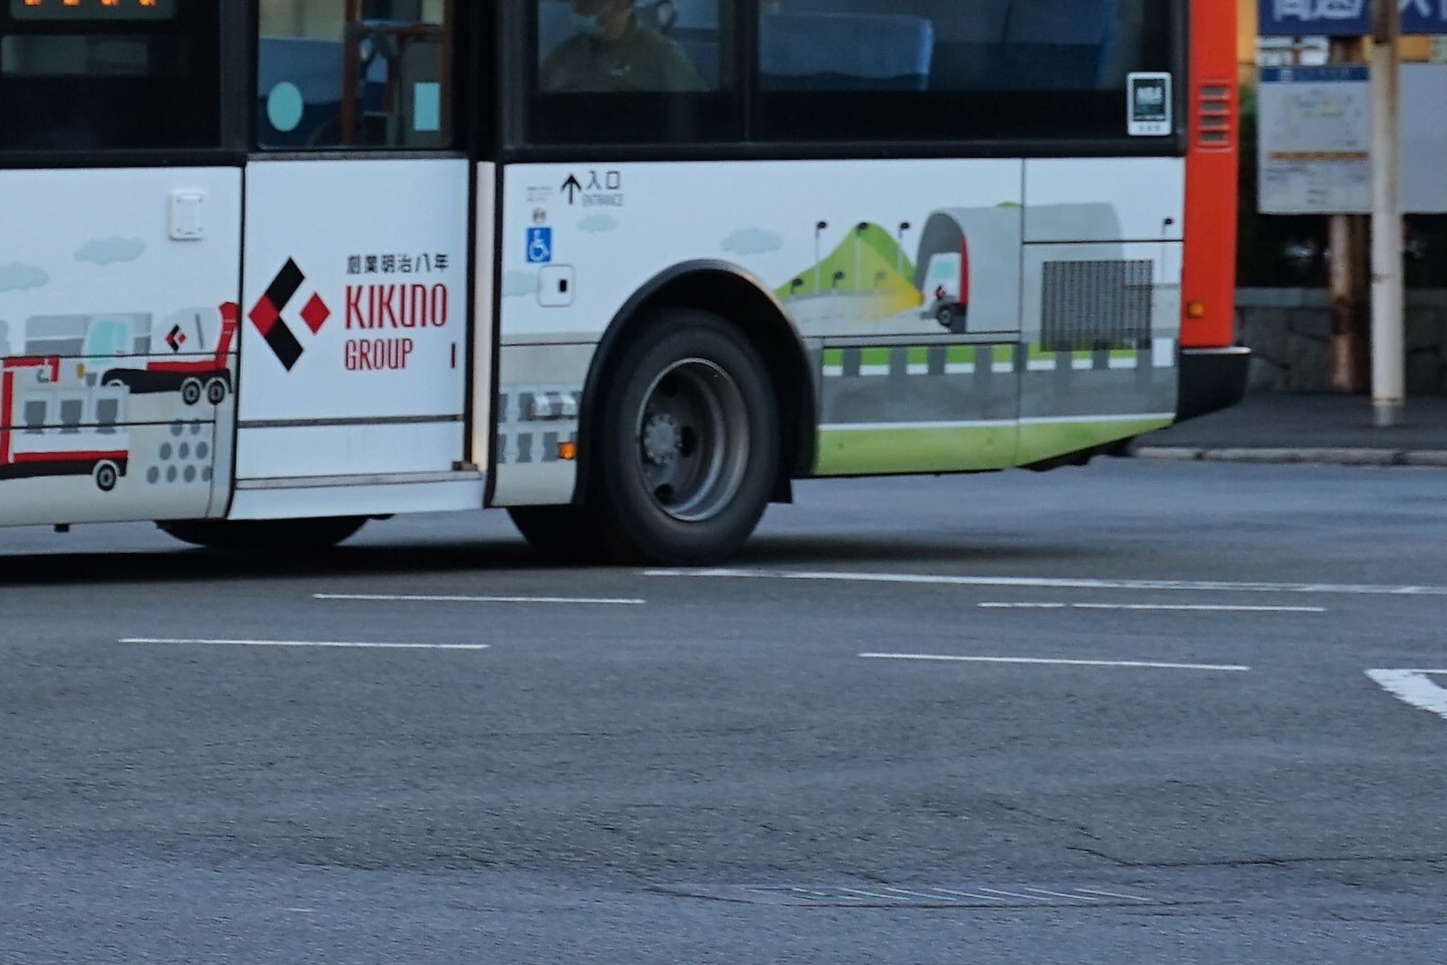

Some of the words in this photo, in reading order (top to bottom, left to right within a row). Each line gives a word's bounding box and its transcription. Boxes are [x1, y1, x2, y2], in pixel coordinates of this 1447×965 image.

[586, 170, 621, 190] 入口
[346, 253, 450, 275] 創業明治八年
[344, 282, 448, 330] KIKUNO
[344, 337, 414, 371] GROUP
